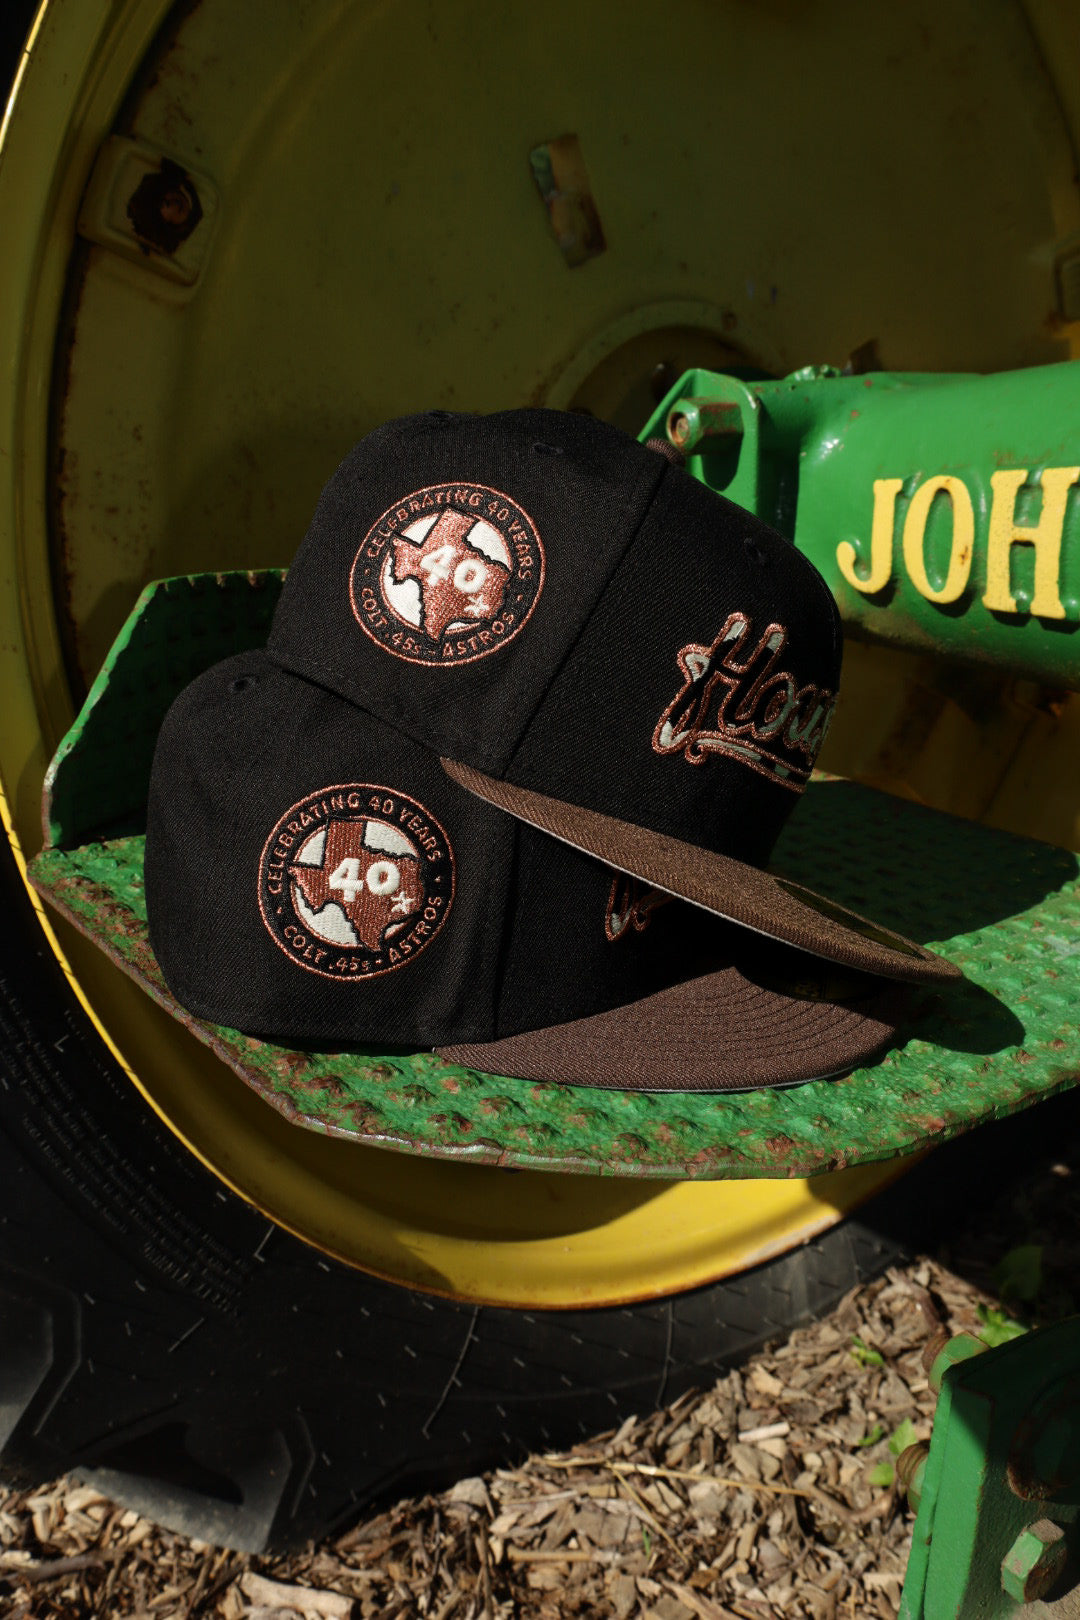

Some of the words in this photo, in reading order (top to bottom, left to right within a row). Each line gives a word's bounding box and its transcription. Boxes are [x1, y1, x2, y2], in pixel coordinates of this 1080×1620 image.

[367, 489, 483, 558] CELEBRATING
[488, 500, 510, 521] 40
[507, 519, 534, 580] YEARS
[420, 544, 489, 593] 40
[836, 466, 1080, 619] JOH
[362, 587, 388, 629] COLT
[442, 612, 515, 658] ASTROS
[652, 611, 836, 790] Hou
[268, 792, 360, 895] CELEBRATING
[368, 795, 394, 815] 40
[398, 807, 442, 862] YEARS
[329, 857, 401, 902] 40
[284, 925, 327, 964] COLT
[388, 896, 442, 964] ASTROS
